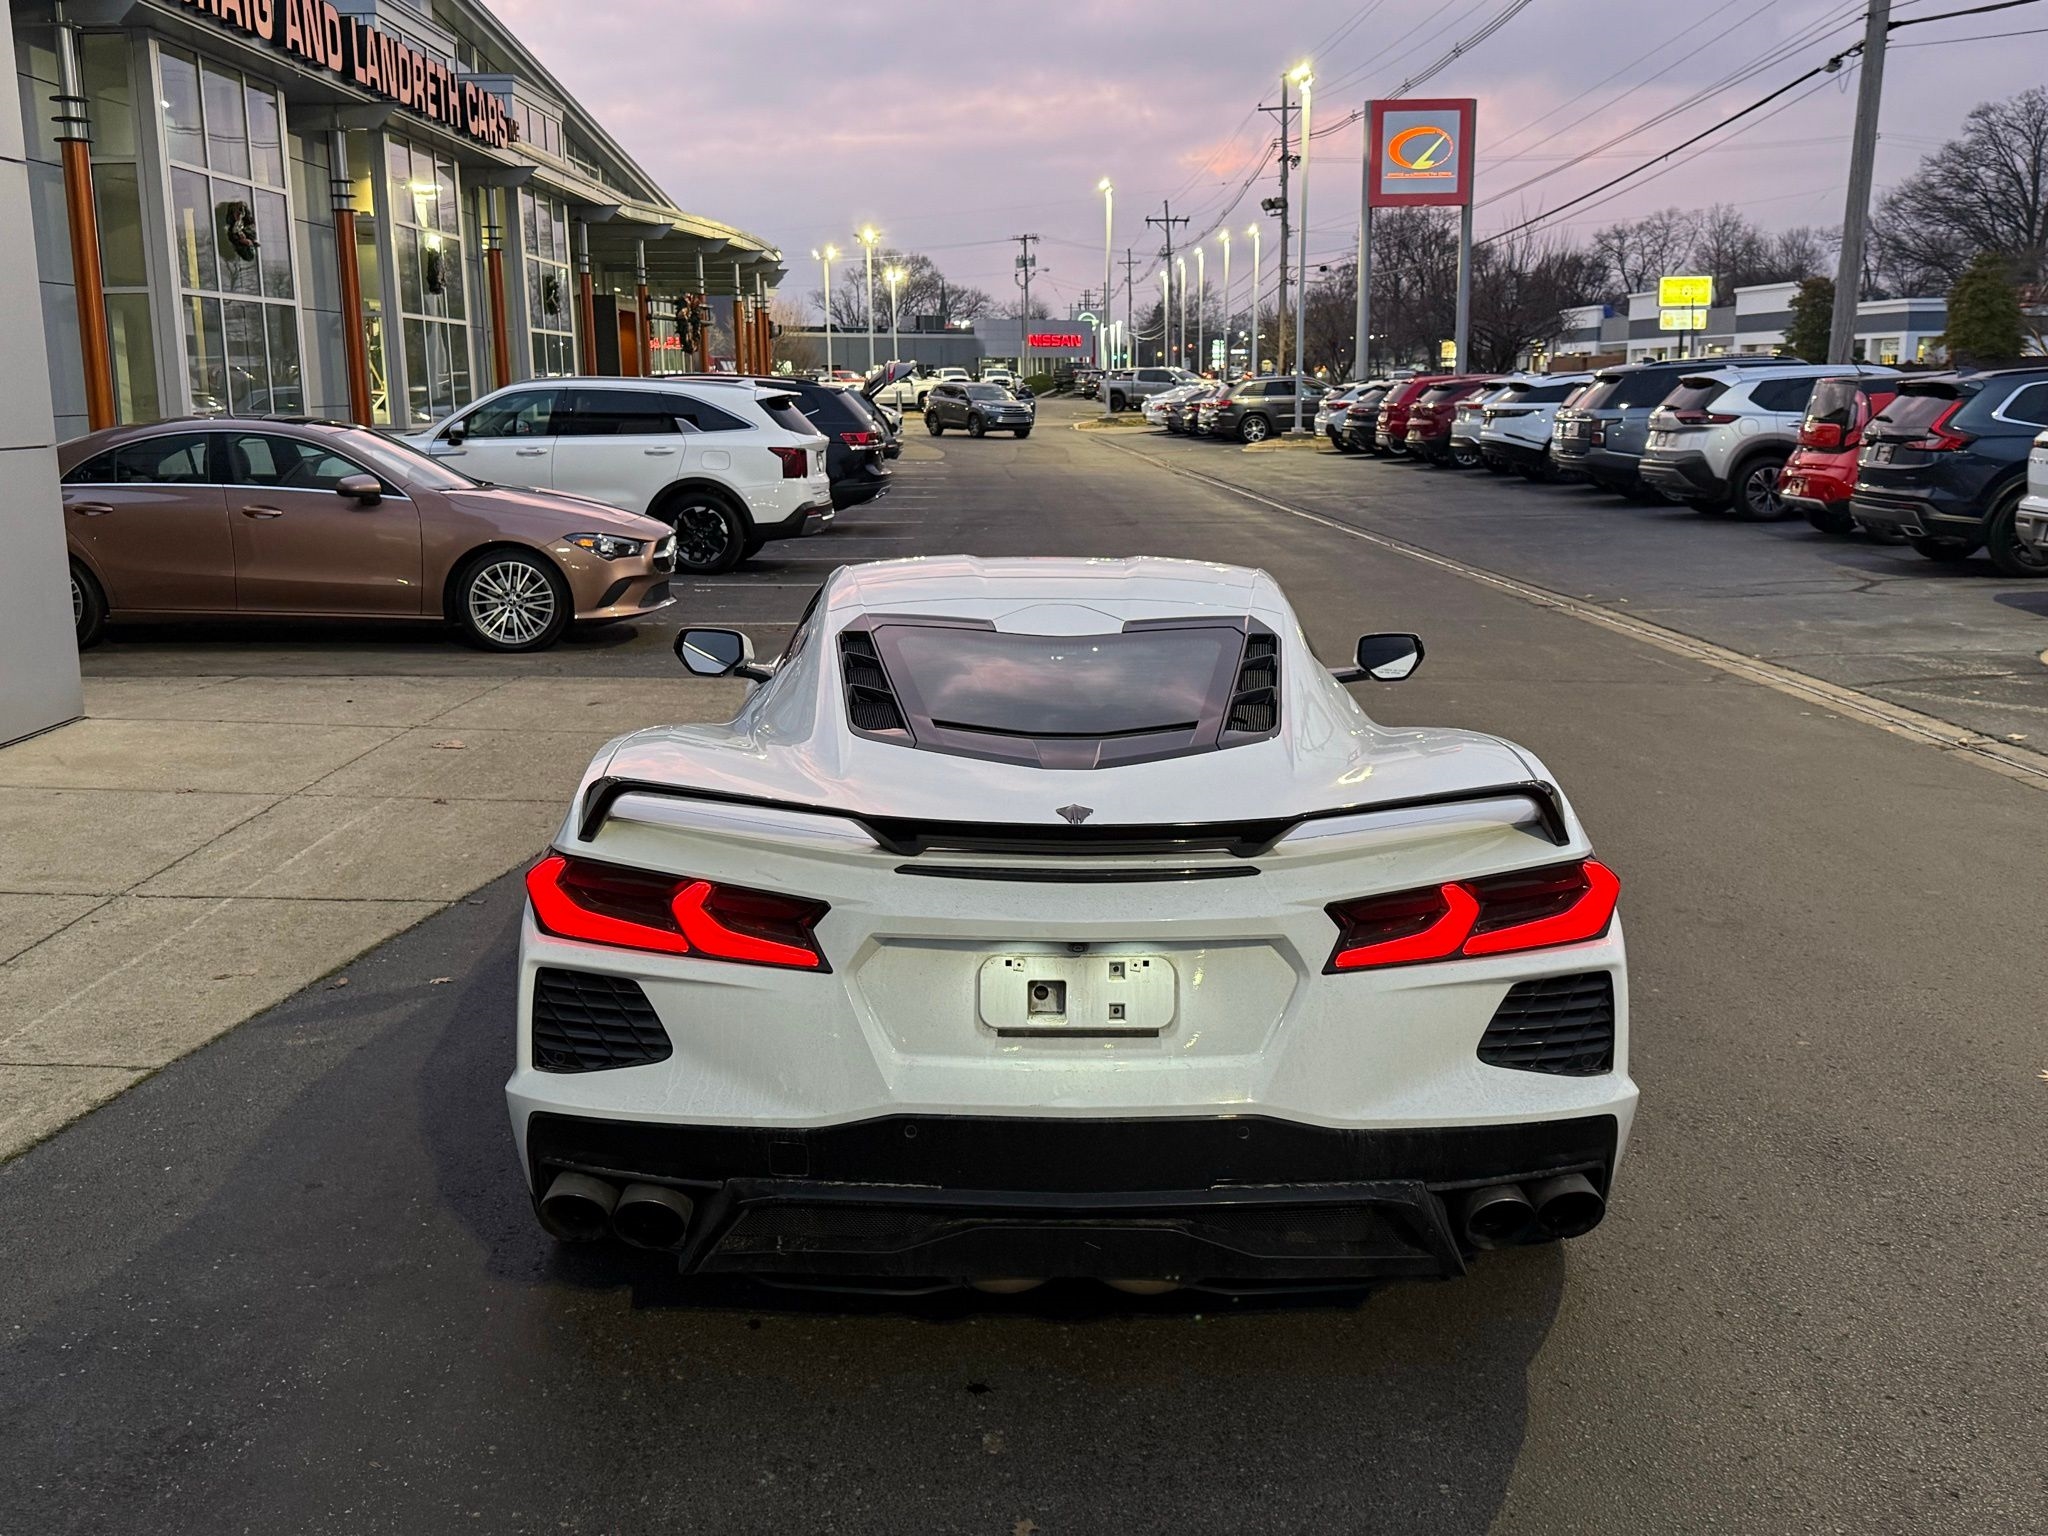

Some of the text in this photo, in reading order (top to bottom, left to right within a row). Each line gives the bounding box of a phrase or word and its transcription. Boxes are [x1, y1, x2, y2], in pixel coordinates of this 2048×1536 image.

[286, 0, 343, 72] AND
[351, 16, 461, 128] LANDRETH
[466, 81, 509, 149] CARS
[1028, 334, 1083, 347] NISSAN
